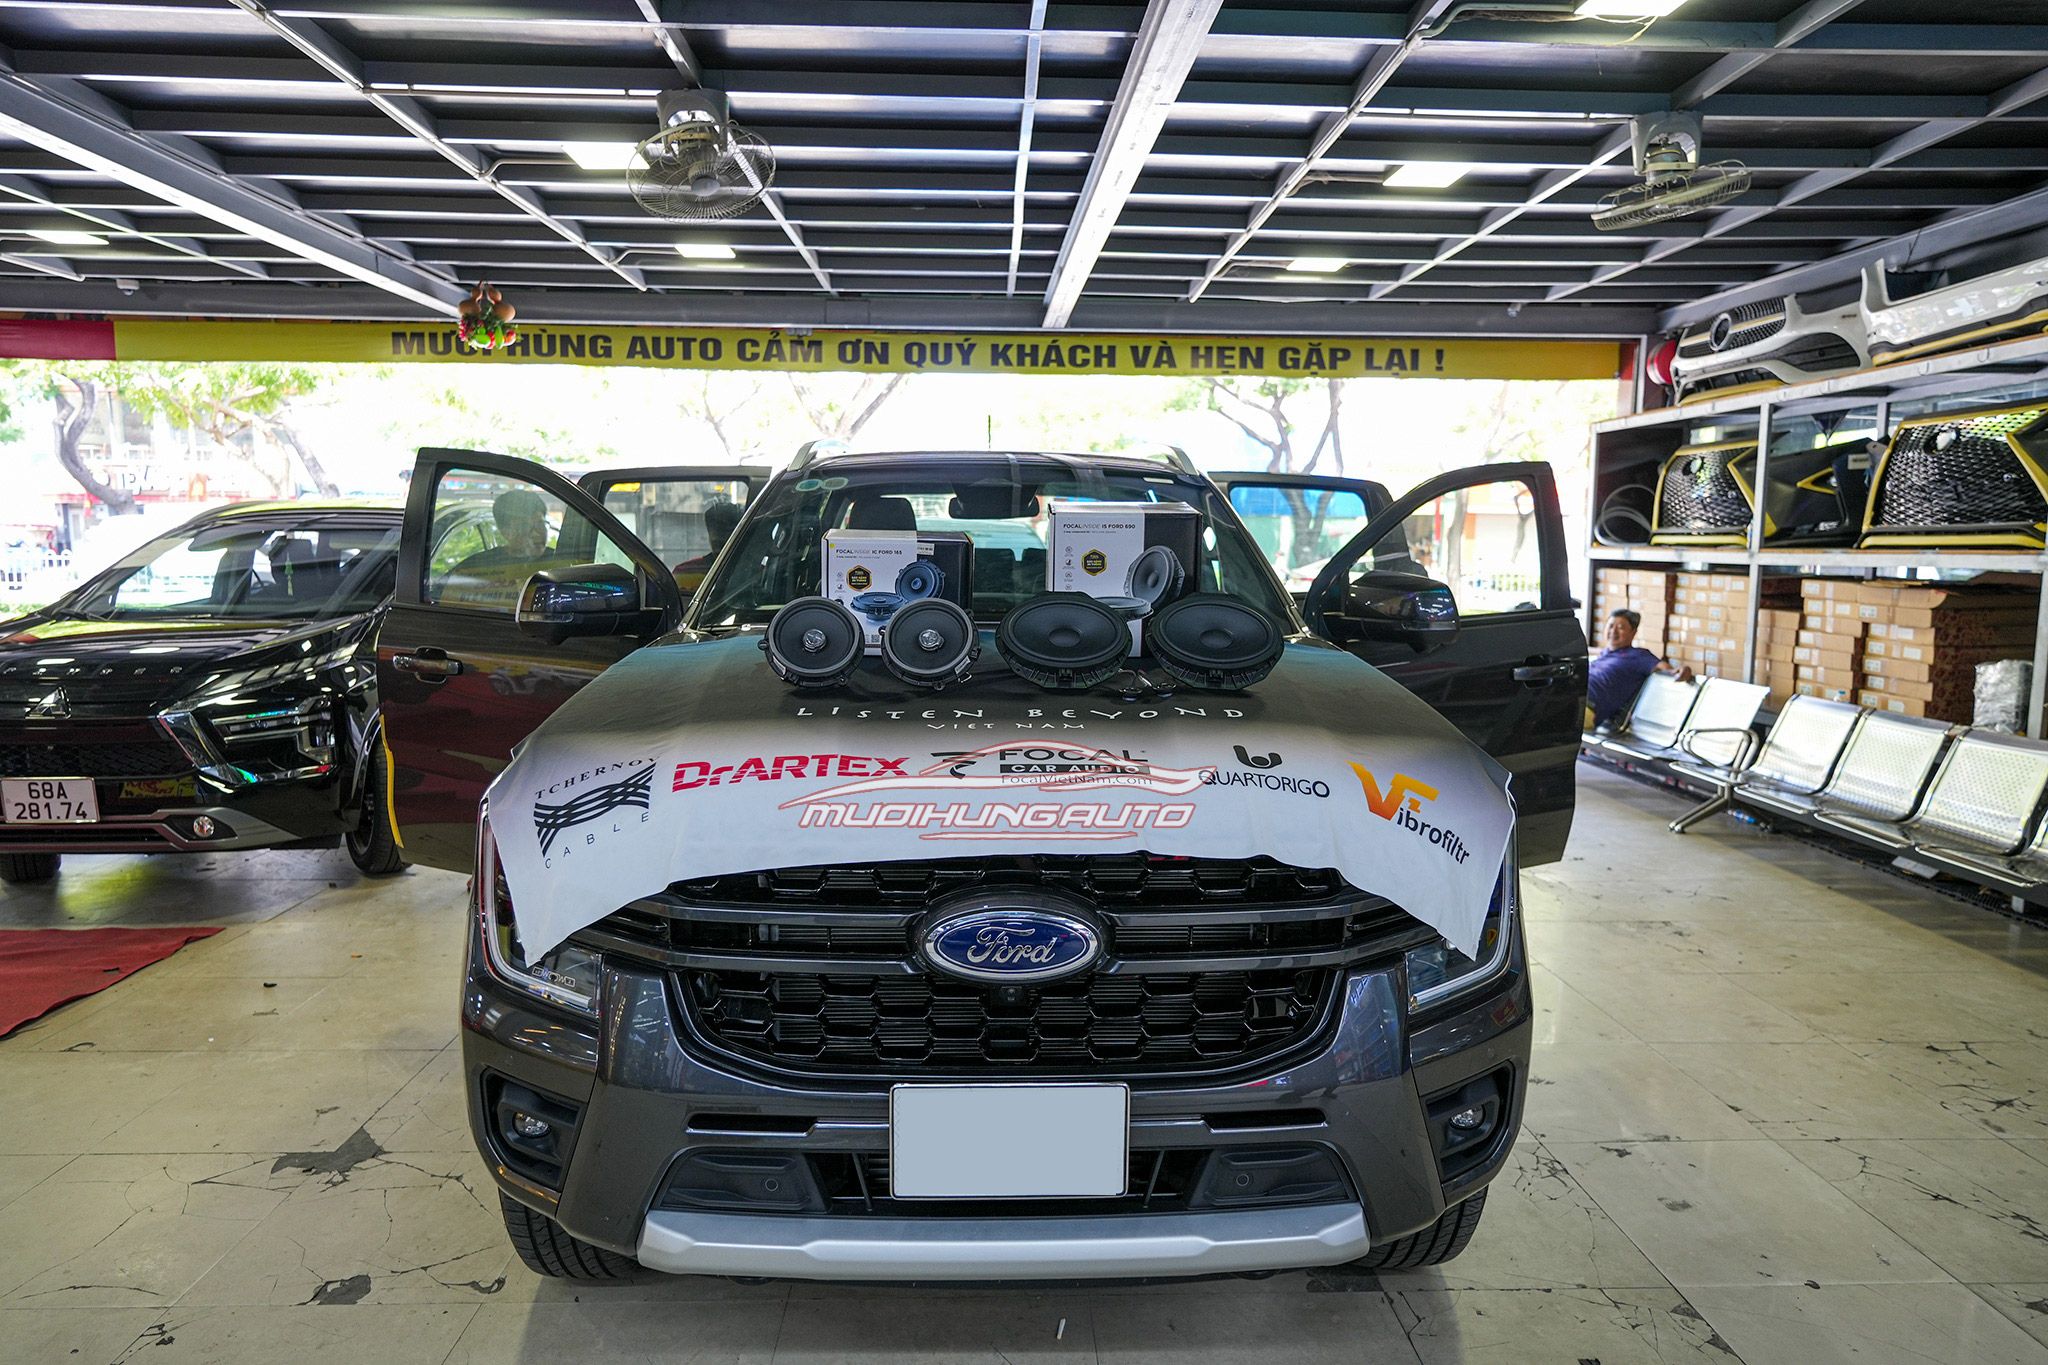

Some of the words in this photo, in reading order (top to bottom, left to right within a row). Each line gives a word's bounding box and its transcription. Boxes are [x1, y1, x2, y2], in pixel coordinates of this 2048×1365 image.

[507, 328, 613, 359] HÙNG
[626, 335, 723, 361] AUTO
[737, 331, 823, 364] CẢM
[838, 338, 890, 365] ƠN
[904, 337, 977, 368] QUÝ
[990, 339, 1117, 369] KHÁCH
[1129, 340, 1178, 370] VÀ
[1190, 345, 1265, 375] HẸN
[1278, 341, 1352, 376] GẶP
[1365, 347, 1420, 376] LẠI
[796, 706, 984, 720] LISTEN
[1027, 706, 1244, 720] BEYOND
[927, 722, 995, 730] VIET
[1015, 722, 1085, 730] NAM
[999, 748, 1149, 763] FOCAL
[1011, 764, 1057, 774] CAR
[1068, 764, 1140, 774] AUDIO
[27, 781, 69, 800] 68A
[1198, 769, 1331, 799] QUARTORIGO
[14, 801, 88, 820] 281.74
[544, 811, 650, 869] CABLE
[966, 925, 1056, 964] Ford
